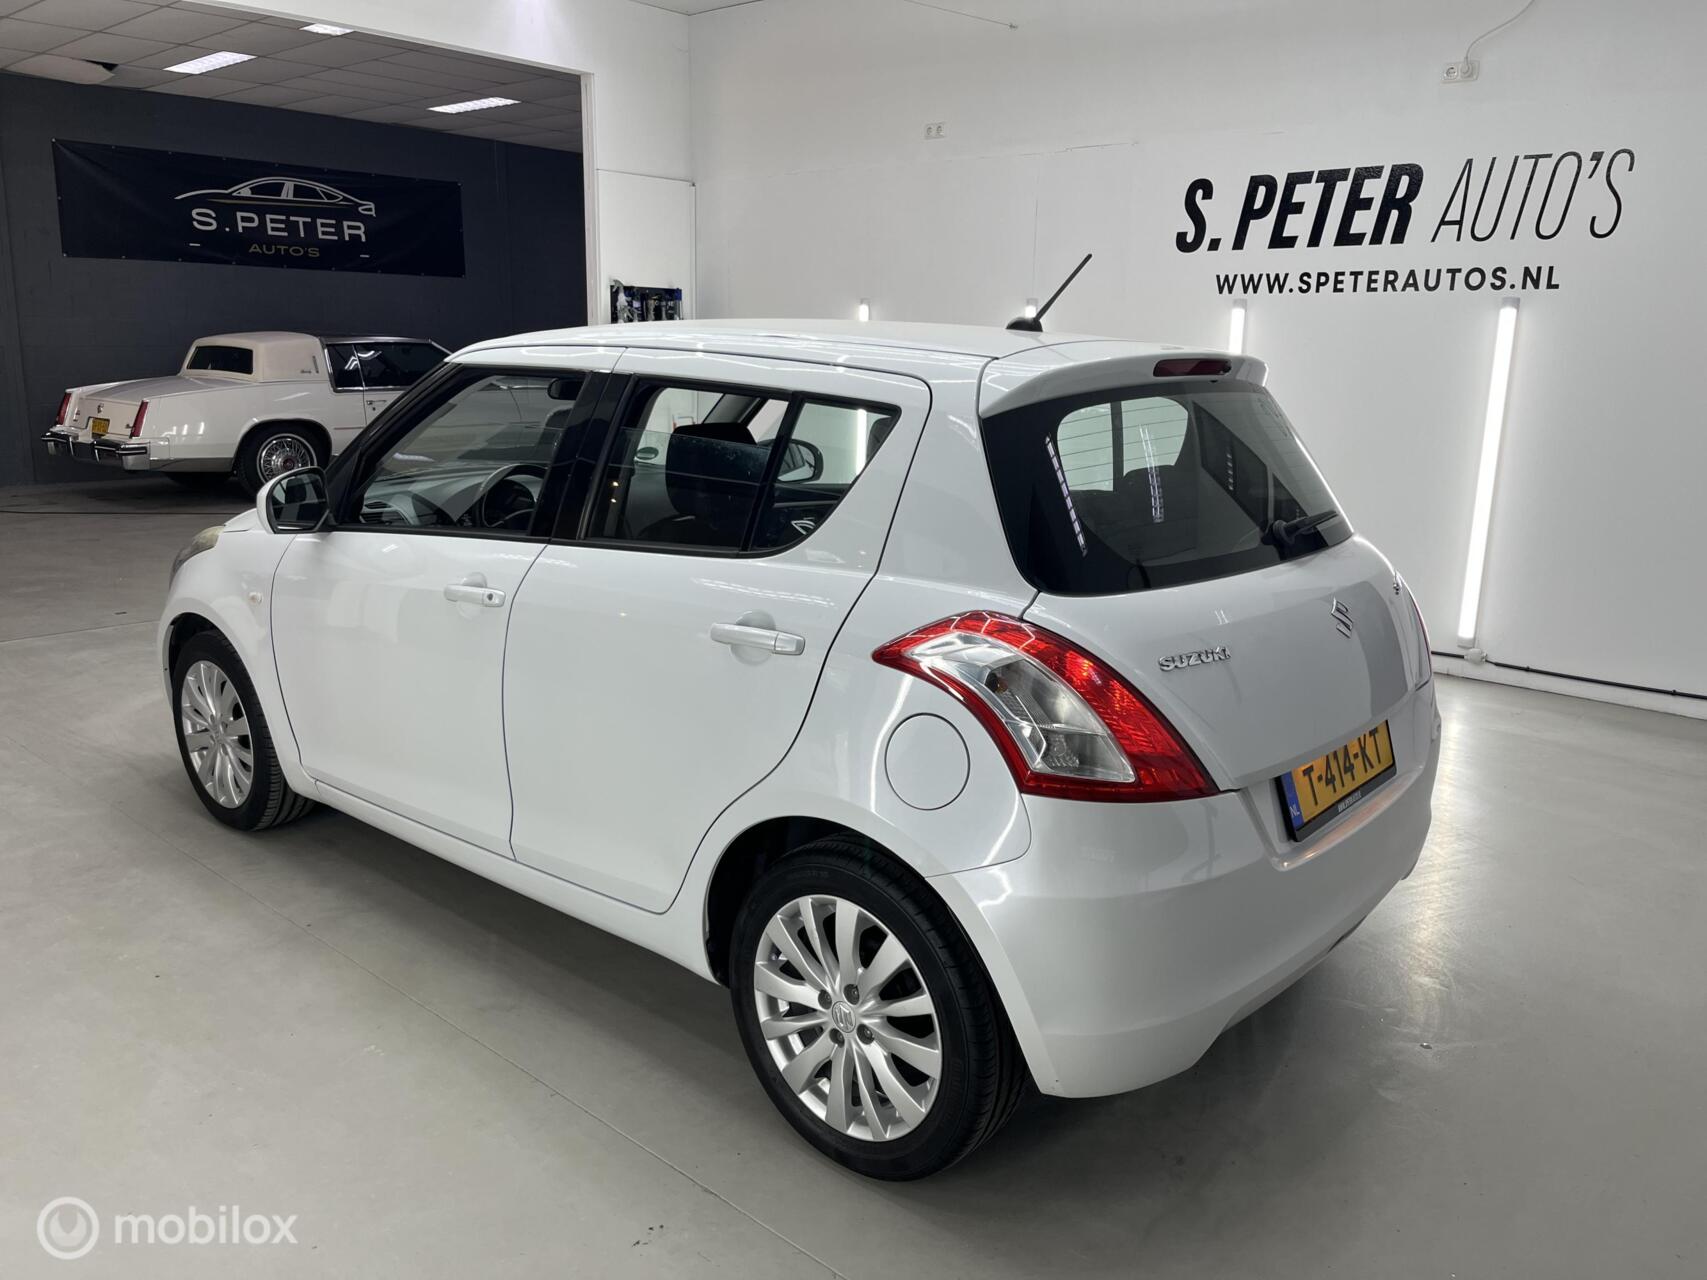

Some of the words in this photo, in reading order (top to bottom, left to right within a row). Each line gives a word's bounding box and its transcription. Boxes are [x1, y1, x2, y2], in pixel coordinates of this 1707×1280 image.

[1231, 163, 1424, 250] PETER
[1430, 148, 1635, 243] AUTO'S
[248, 243, 320, 257] AUTO'S
[1215, 266, 1560, 295] WWW.SPETERAUTOS.NL
[1158, 647, 1231, 671] SUZUKI
[1302, 727, 1381, 806] T-414-KT
